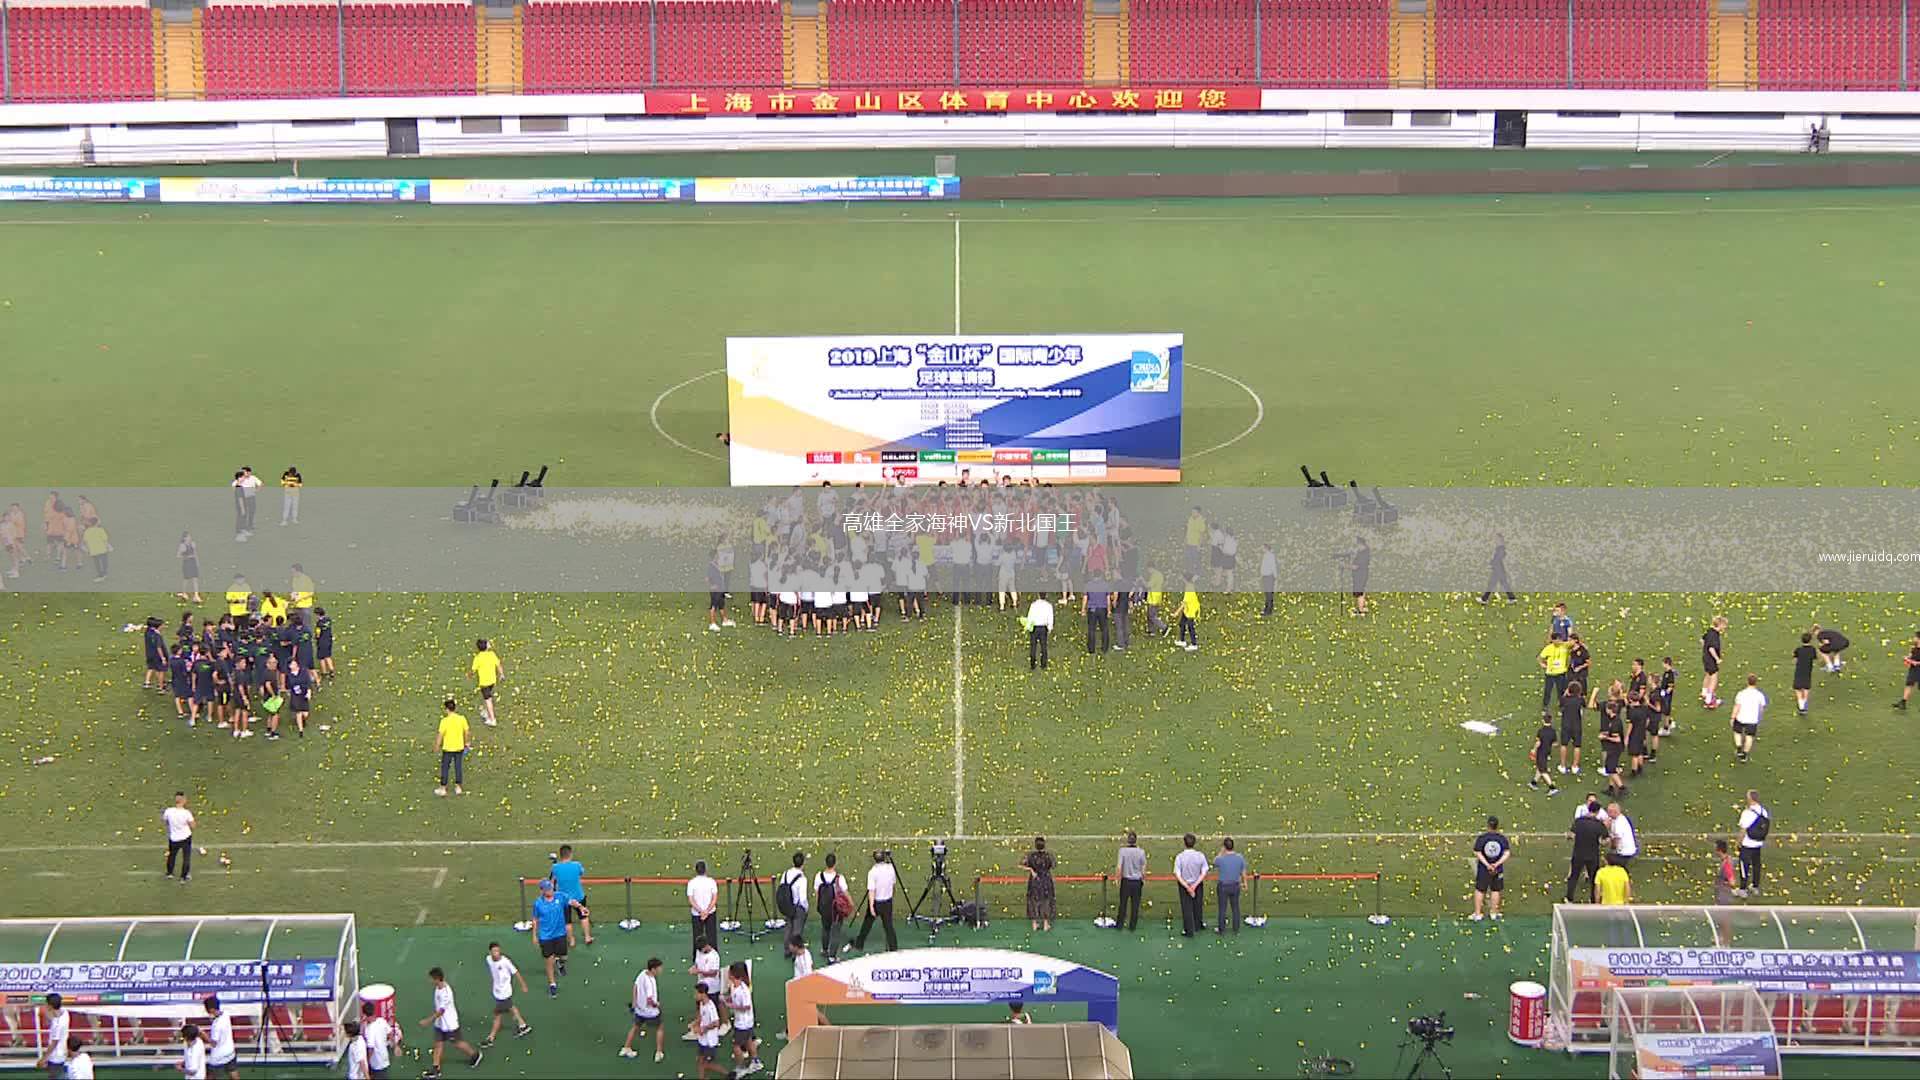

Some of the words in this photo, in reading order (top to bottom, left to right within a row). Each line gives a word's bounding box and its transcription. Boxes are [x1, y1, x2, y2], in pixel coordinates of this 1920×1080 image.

[680, 90, 1227, 112] 上海市金山区体育中心欢迎您
